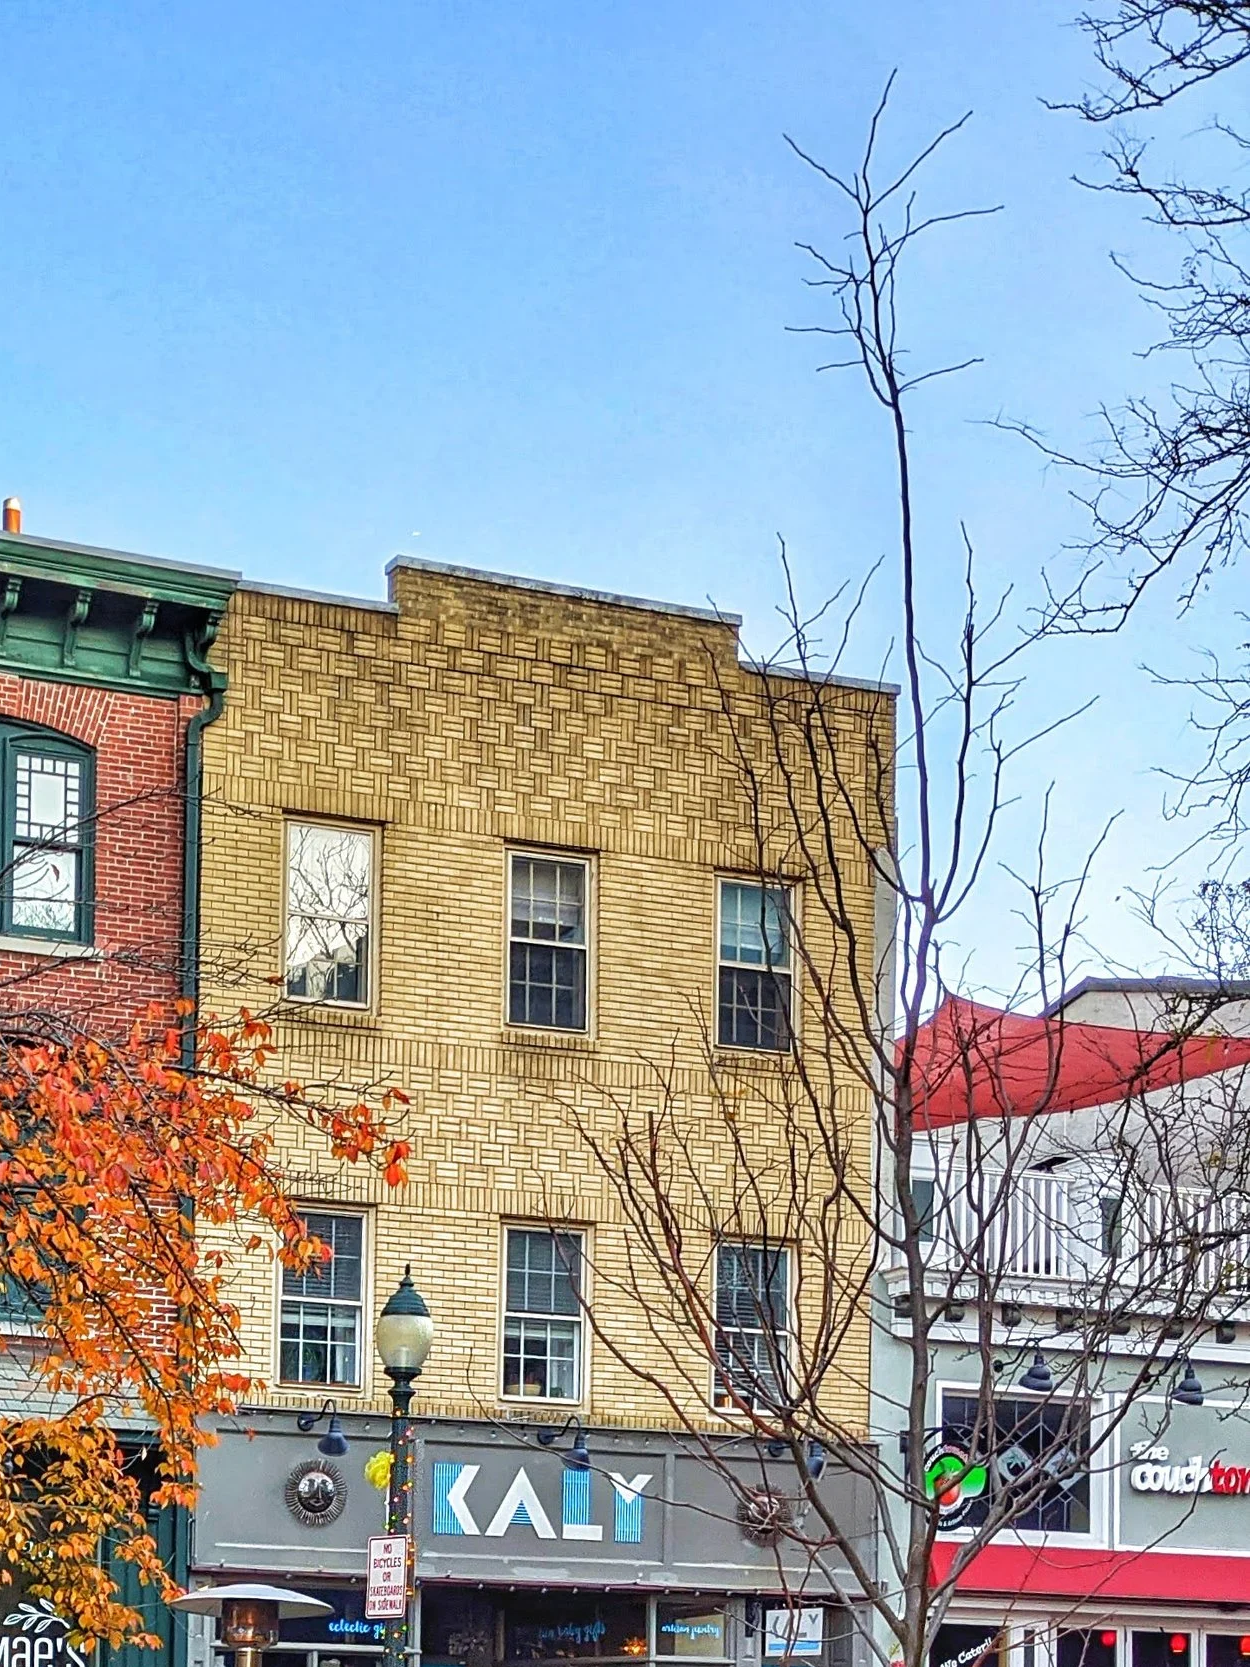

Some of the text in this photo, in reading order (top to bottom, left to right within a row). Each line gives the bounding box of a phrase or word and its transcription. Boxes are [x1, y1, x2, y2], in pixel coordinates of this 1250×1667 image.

[1130, 1440, 1170, 1461] the
[433, 1463, 654, 1543] KALY
[383, 1543, 392, 1554] NO
[373, 1557, 402, 1568] BICYCLES
[382, 1572, 391, 1582] OR
[370, 1585, 403, 1597] SKATEBOARDS
[378, 1600, 402, 1611] SIDEWALK
[328, 1619, 370, 1633] eclectic
